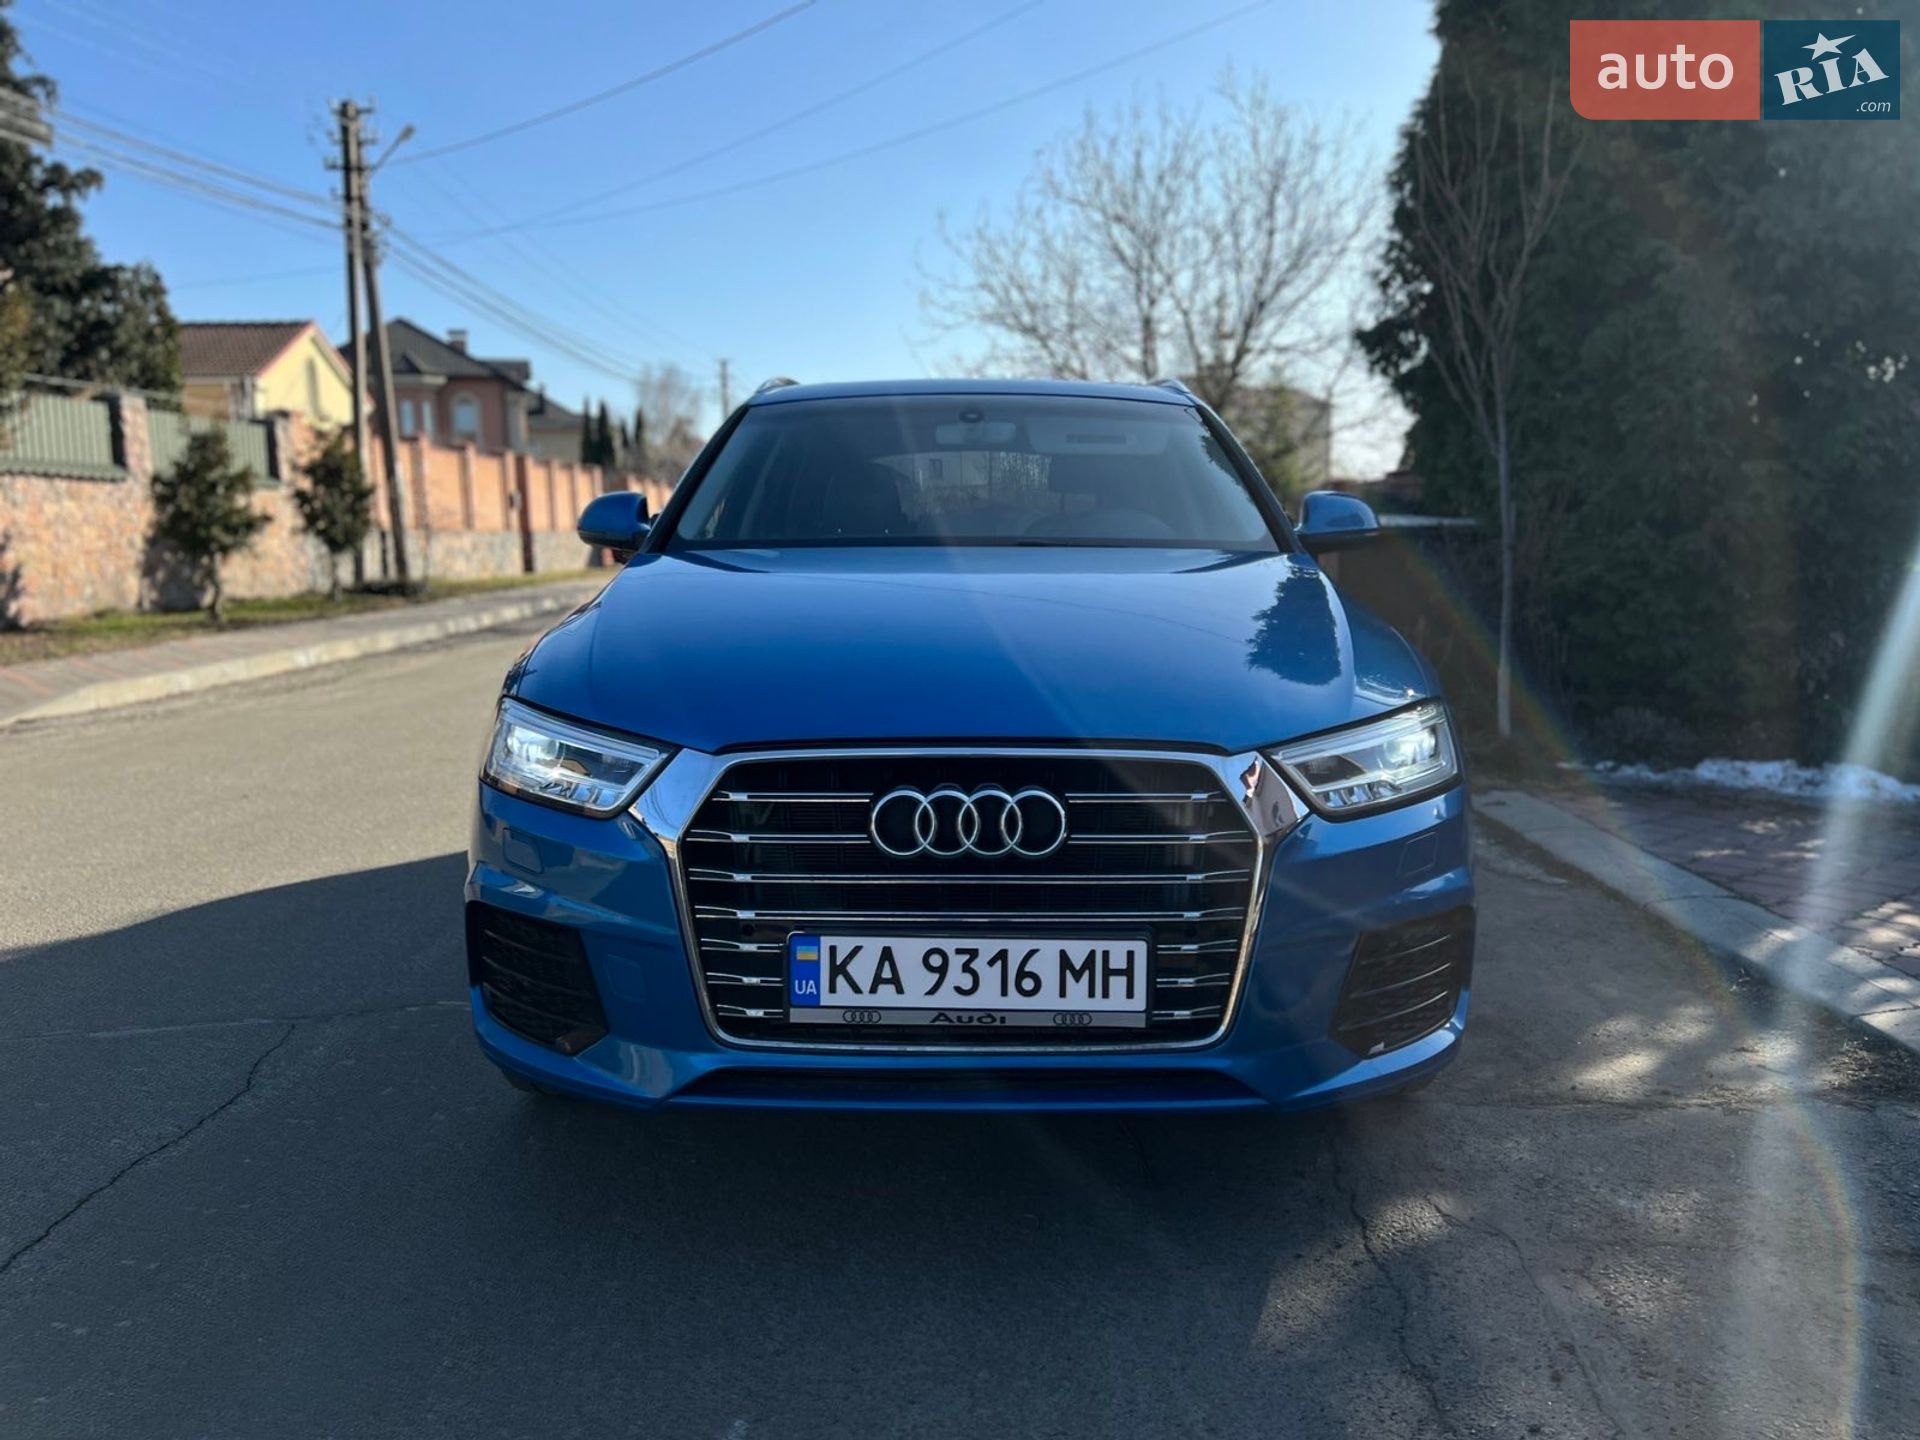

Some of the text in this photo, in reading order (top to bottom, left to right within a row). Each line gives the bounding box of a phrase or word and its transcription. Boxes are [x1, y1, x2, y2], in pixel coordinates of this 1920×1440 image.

[828, 944, 1136, 1000] KA 9316 MH
[794, 979, 818, 996] UA
[929, 1011, 1007, 1025] Audi
